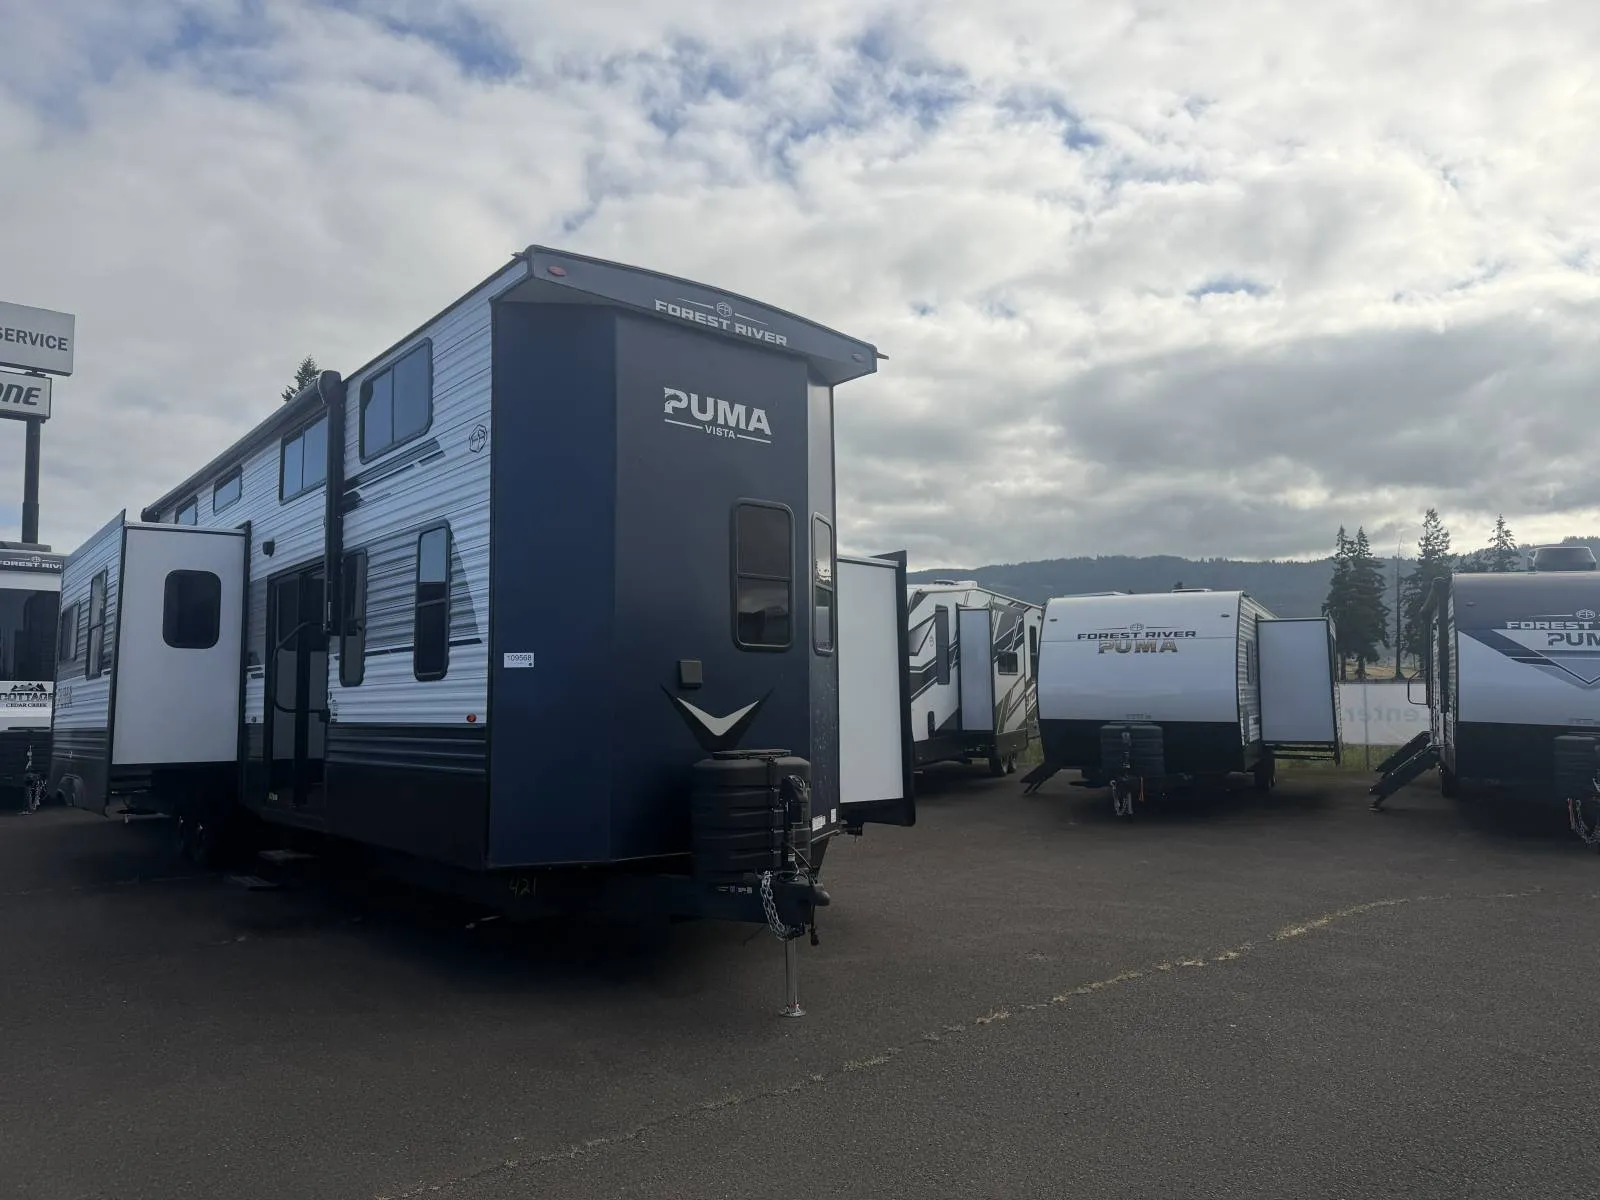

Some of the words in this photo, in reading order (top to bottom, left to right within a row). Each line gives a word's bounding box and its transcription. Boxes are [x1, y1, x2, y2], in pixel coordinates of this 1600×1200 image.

[655, 299, 730, 330] FOREST
[735, 324, 787, 346] RIVER
[0, 326, 68, 352] ERVICE
[0, 382, 42, 406] NE
[664, 387, 772, 436] PUMA
[704, 424, 736, 439] VISTA
[1077, 631, 1141, 640] FOREST
[1145, 630, 1196, 639] RIVER
[1505, 621, 1593, 630] FOREST
[1098, 639, 1178, 654] PUMA
